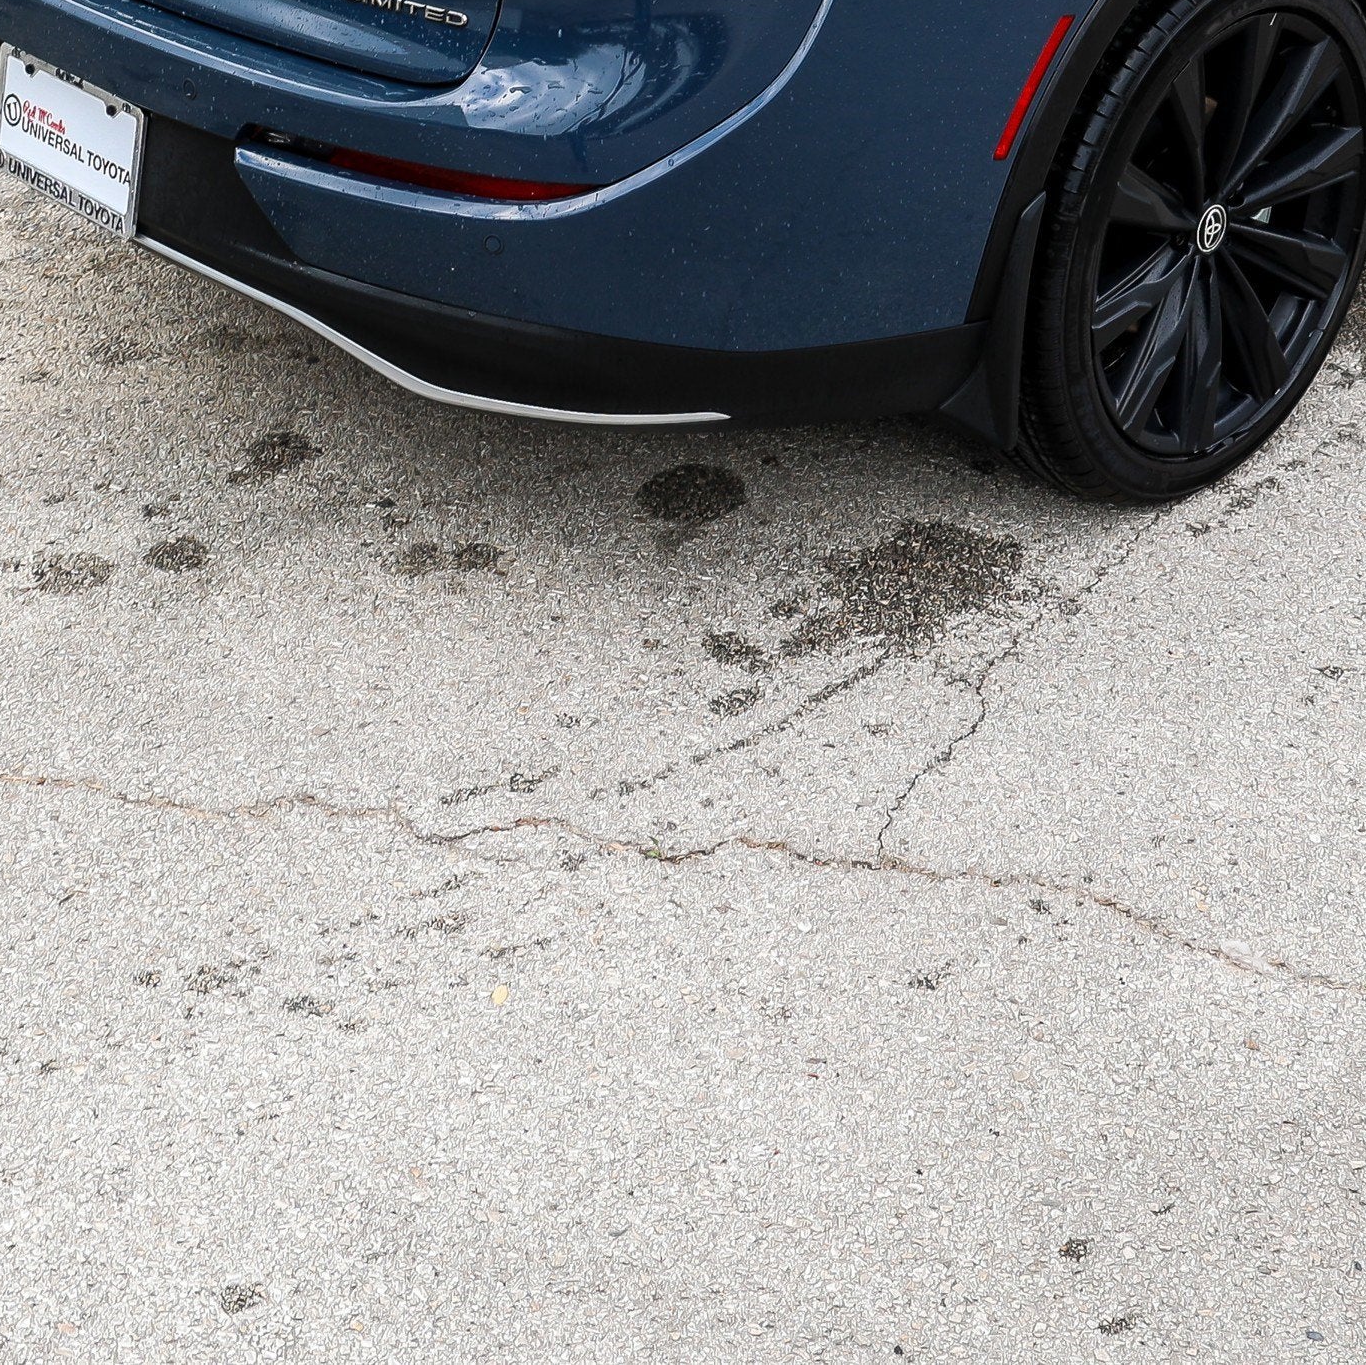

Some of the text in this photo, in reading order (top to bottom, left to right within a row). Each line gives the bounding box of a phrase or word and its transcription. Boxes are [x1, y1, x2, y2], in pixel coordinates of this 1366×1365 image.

[21, 116, 131, 185] UNIVERSAL TOYOTA
[8, 157, 76, 207] UNIVERSAL
[77, 191, 125, 234] TOYOTA
